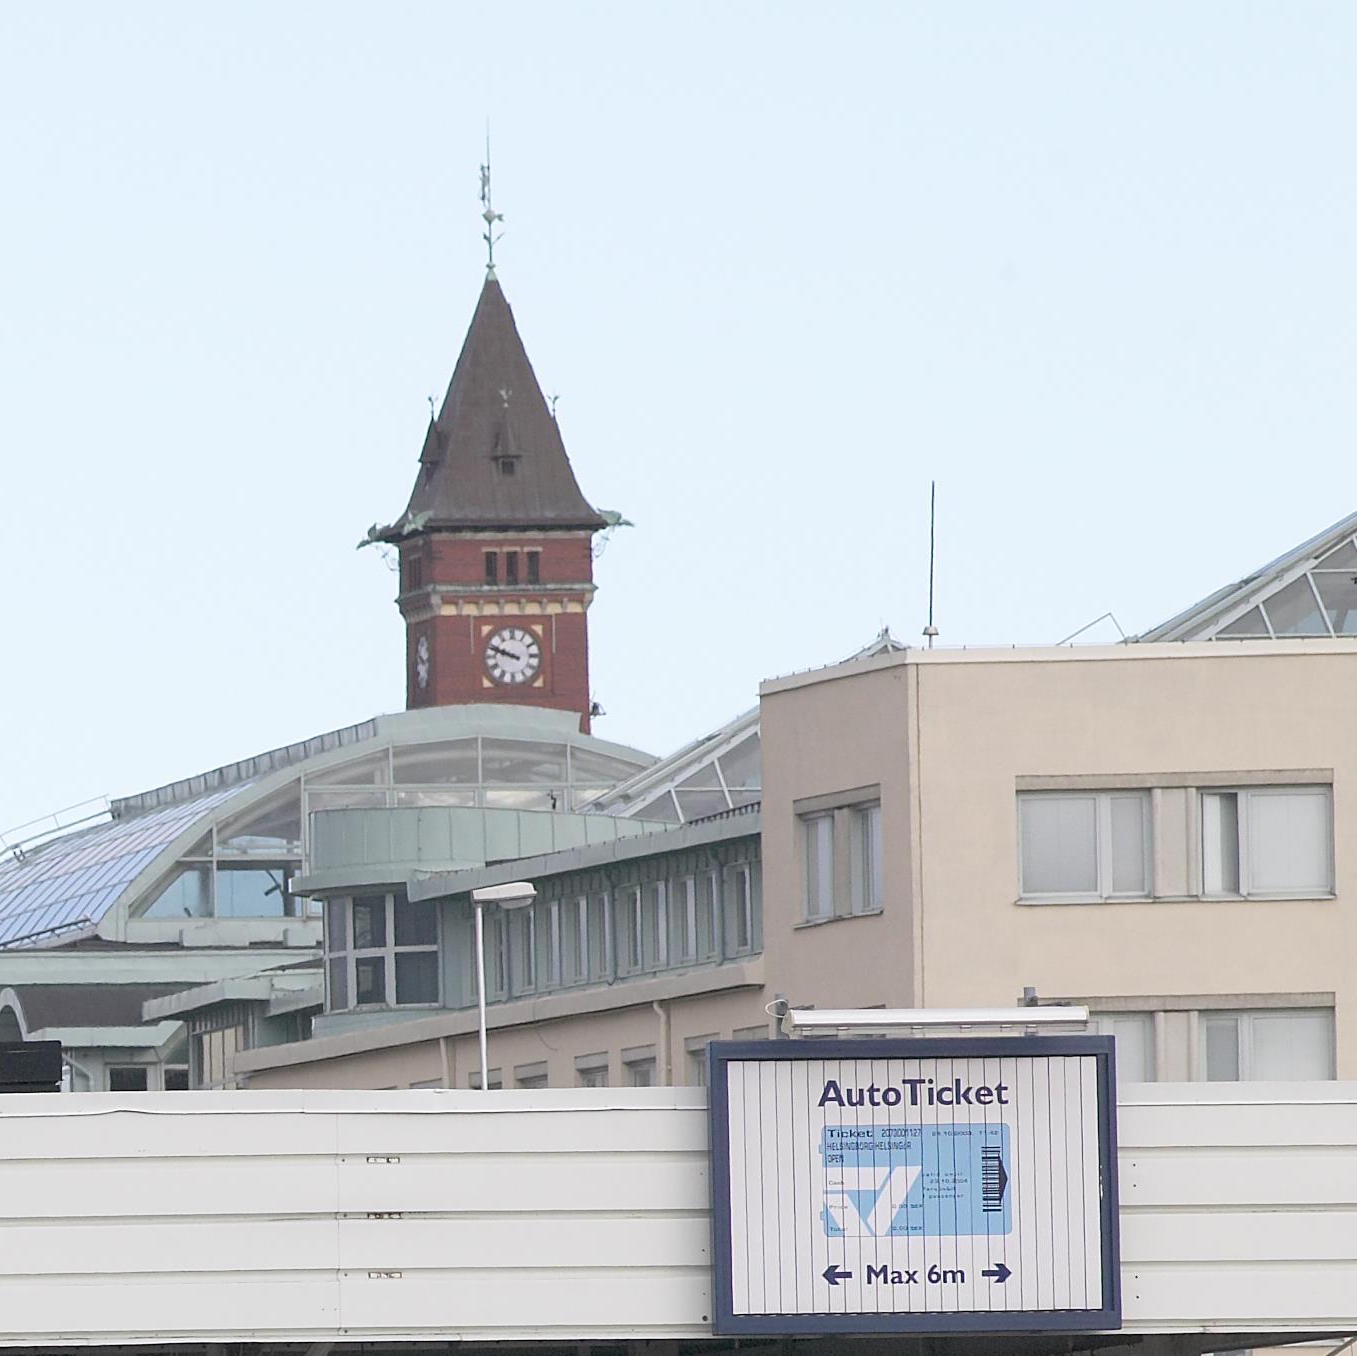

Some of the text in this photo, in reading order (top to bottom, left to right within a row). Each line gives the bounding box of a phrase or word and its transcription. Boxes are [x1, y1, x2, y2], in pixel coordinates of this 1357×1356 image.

[818, 1078, 1010, 1107] AutoTicket
[827, 1128, 873, 1138] Ticket
[866, 1264, 965, 1285] Max 6m
